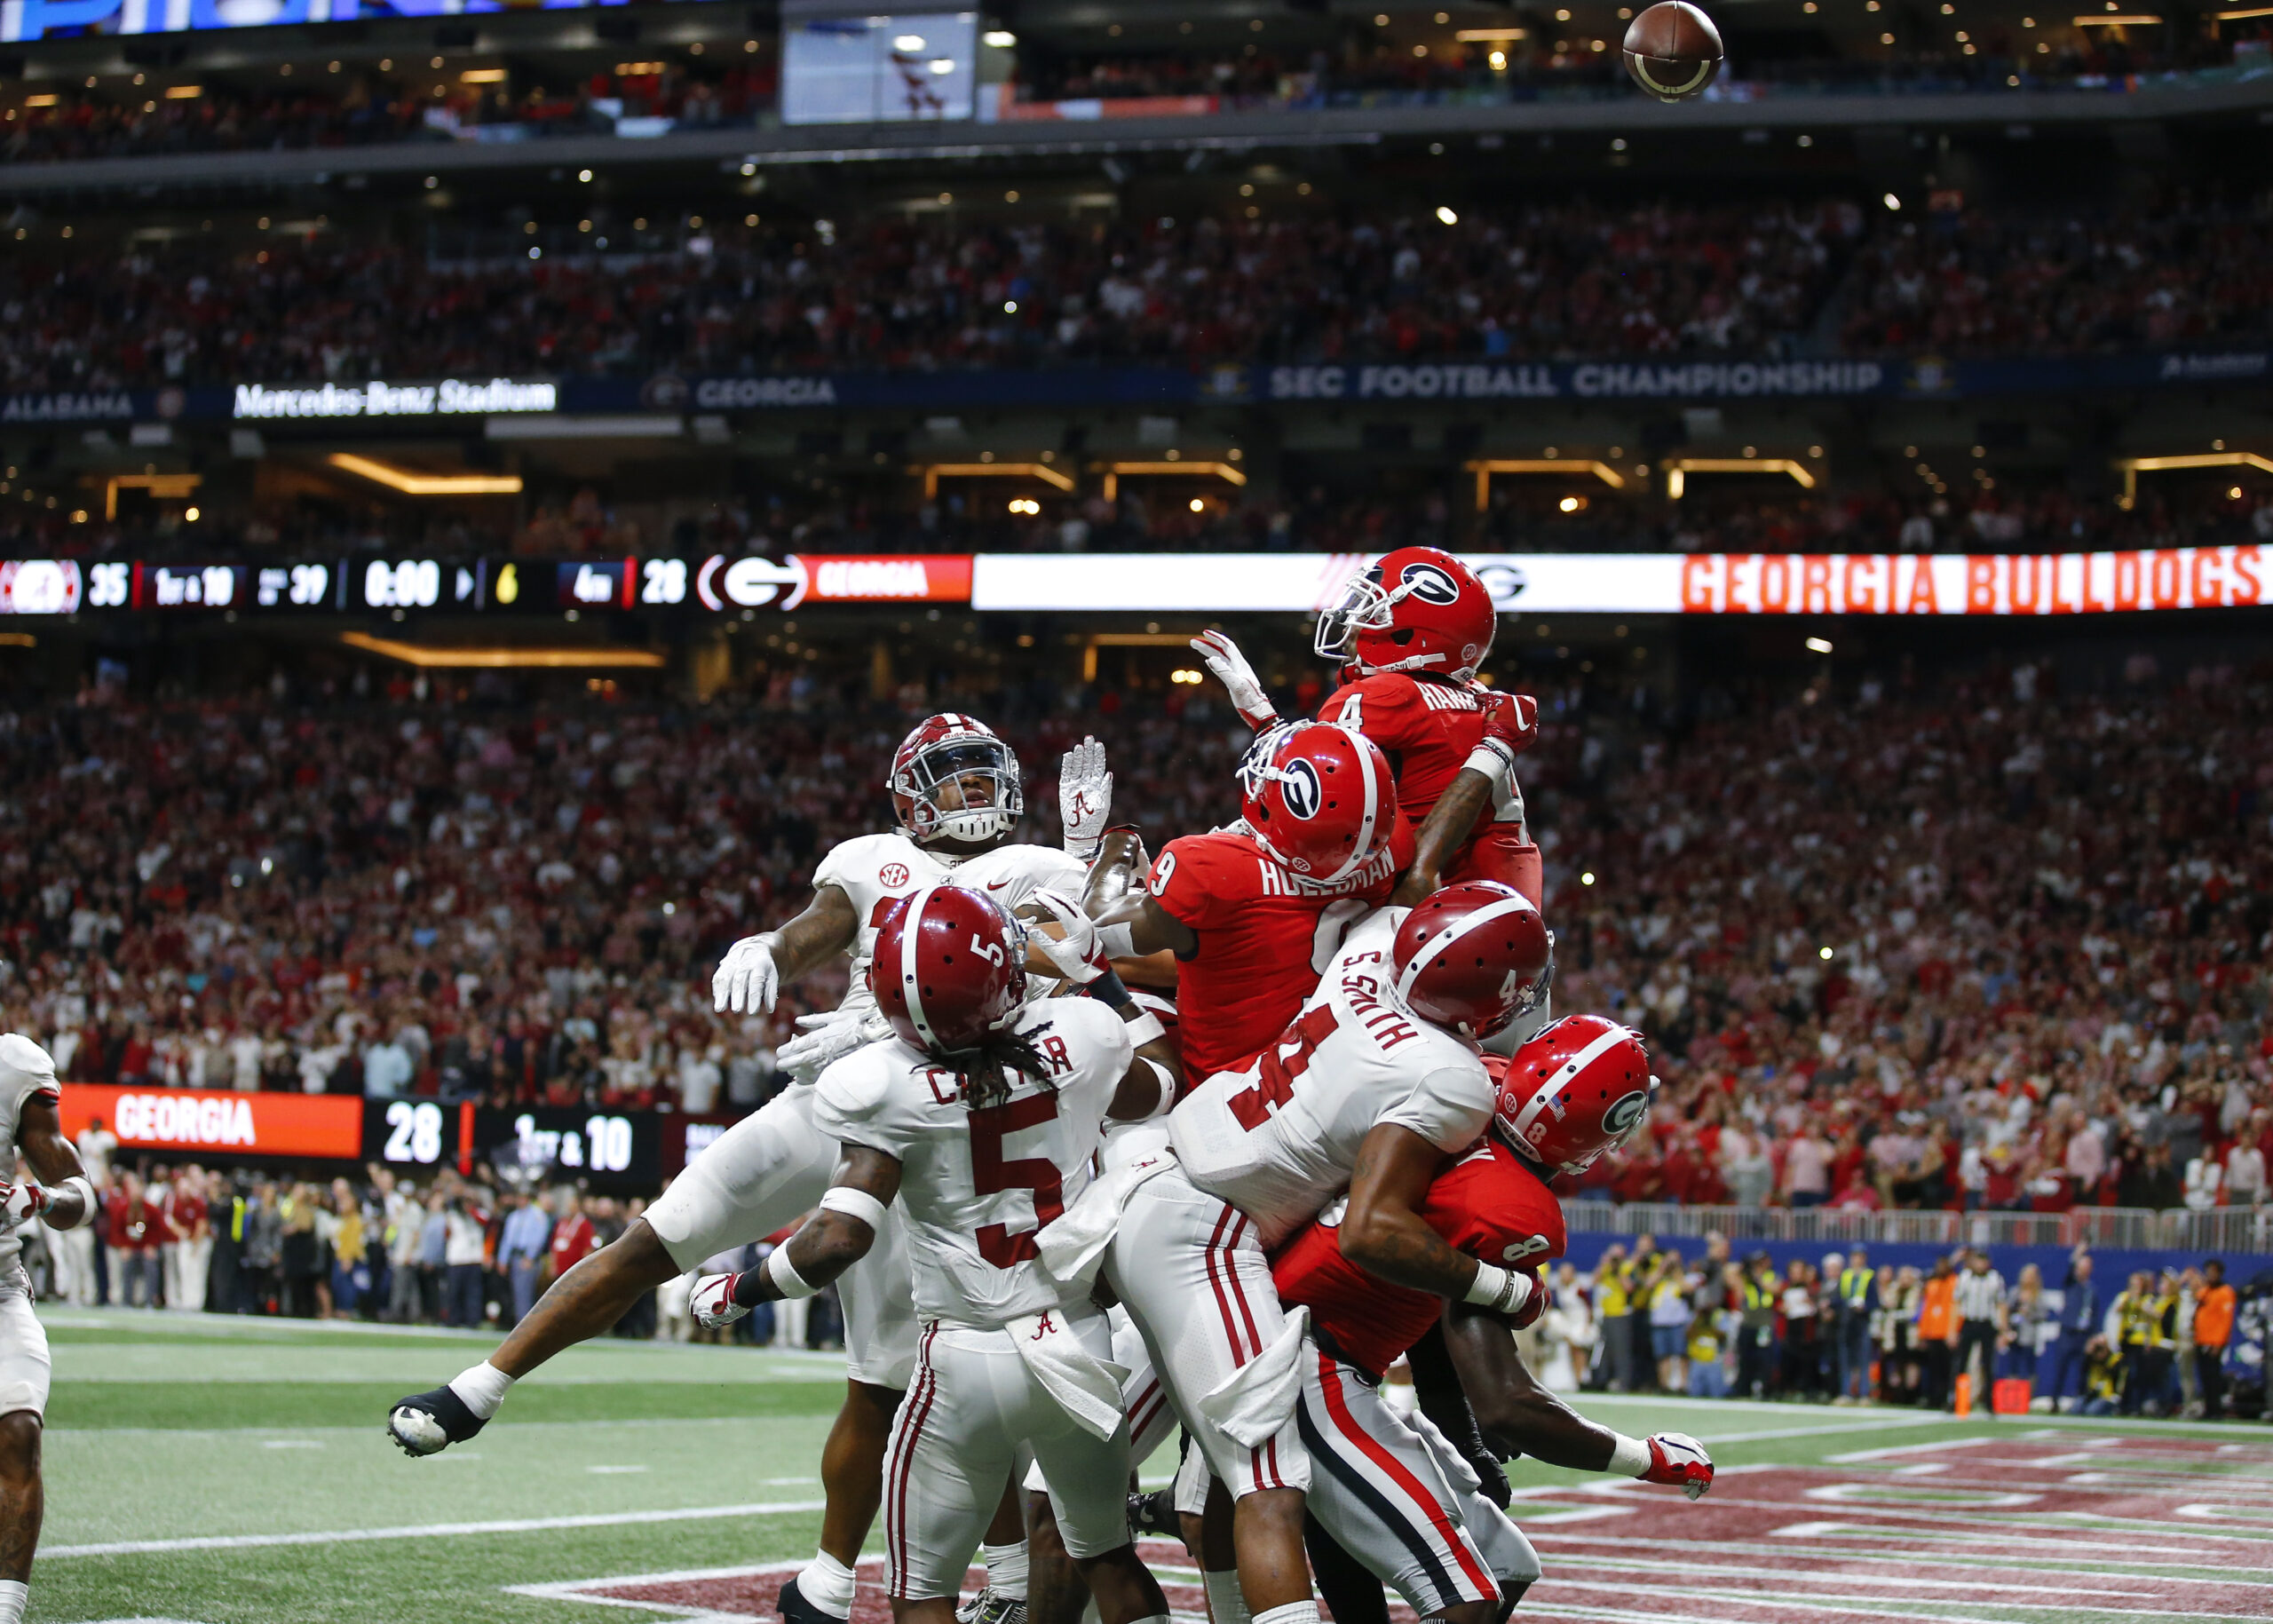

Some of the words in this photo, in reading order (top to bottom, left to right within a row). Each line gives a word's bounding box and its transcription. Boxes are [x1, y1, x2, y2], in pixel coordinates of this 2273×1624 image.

[234, 380, 436, 418] Mercedes-Benz
[438, 378, 557, 414] Stadium
[697, 378, 836, 406] GEORGIA
[1270, 366, 1344, 398] SEC
[1359, 365, 1558, 398] FOOTBALL
[1572, 362, 1882, 398] CHAMPIONSHIP
[3, 392, 133, 422] ALABAMA
[89, 563, 129, 606] 35
[289, 564, 329, 605] 39
[365, 559, 440, 607] 0:00
[496, 563, 519, 605] 6
[816, 561, 929, 598] GEORGIA
[1681, 555, 1942, 614] GEORGIA
[1965, 548, 2262, 613] BULLDOGS
[1337, 693, 1364, 733] 4
[880, 864, 908, 886] SEC
[1151, 851, 1176, 897] 9
[970, 932, 1004, 969] 5
[1499, 969, 1517, 1006] 4
[1342, 975, 1420, 1051] SMITH
[1226, 1002, 1339, 1133] 4
[115, 1094, 256, 1146] GEORGIA
[384, 1101, 443, 1163] 28
[1527, 1122, 1548, 1145] 8
[560, 1130, 583, 1168] &
[585, 1114, 633, 1172] 10
[967, 1089, 1065, 1270] 5
[1502, 1232, 1551, 1262] 8
